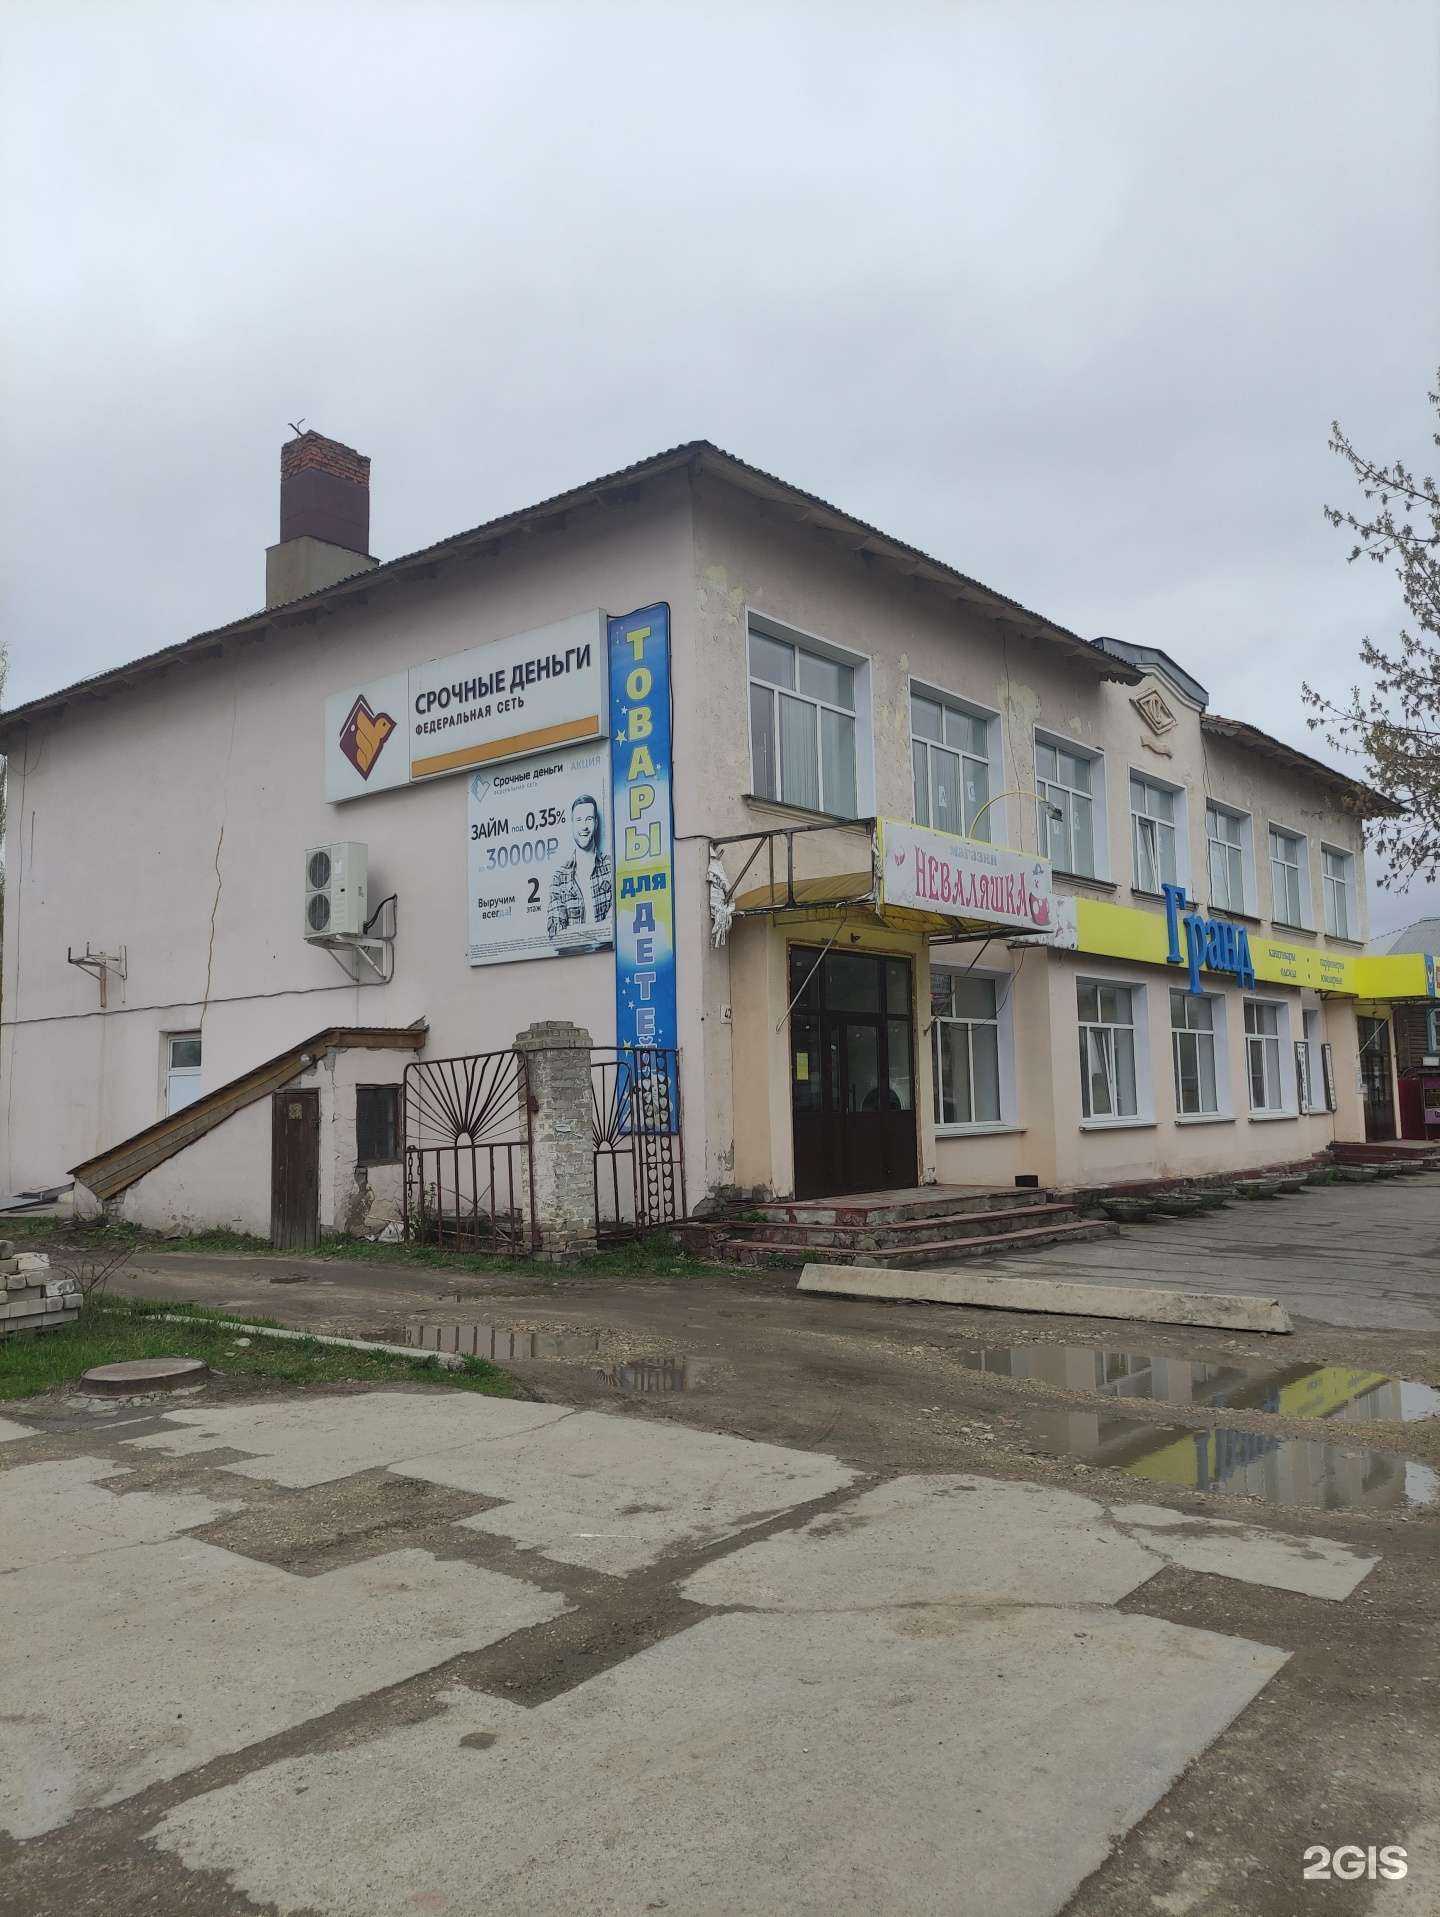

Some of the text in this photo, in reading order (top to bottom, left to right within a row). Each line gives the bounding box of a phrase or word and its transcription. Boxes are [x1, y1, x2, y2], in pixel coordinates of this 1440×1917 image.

[415, 644, 591, 715] СРОЧНЫЕ ДЕНЬГИ
[415, 696, 525, 736] ФЕДЕРАЛЬНАЯ СЕТЬ
[625, 627, 662, 861] ТОВАРЫ
[493, 770, 531, 788] Срочные
[533, 763, 564, 779] деньги
[471, 817, 509, 840] ЗАЙМ
[525, 807, 566, 831] 0,35%
[527, 877, 541, 903] 2
[915, 846, 1028, 916] НЕВАЛЯШКА
[478, 895, 516, 908] Выручим
[1161, 883, 1255, 993] Гранд
